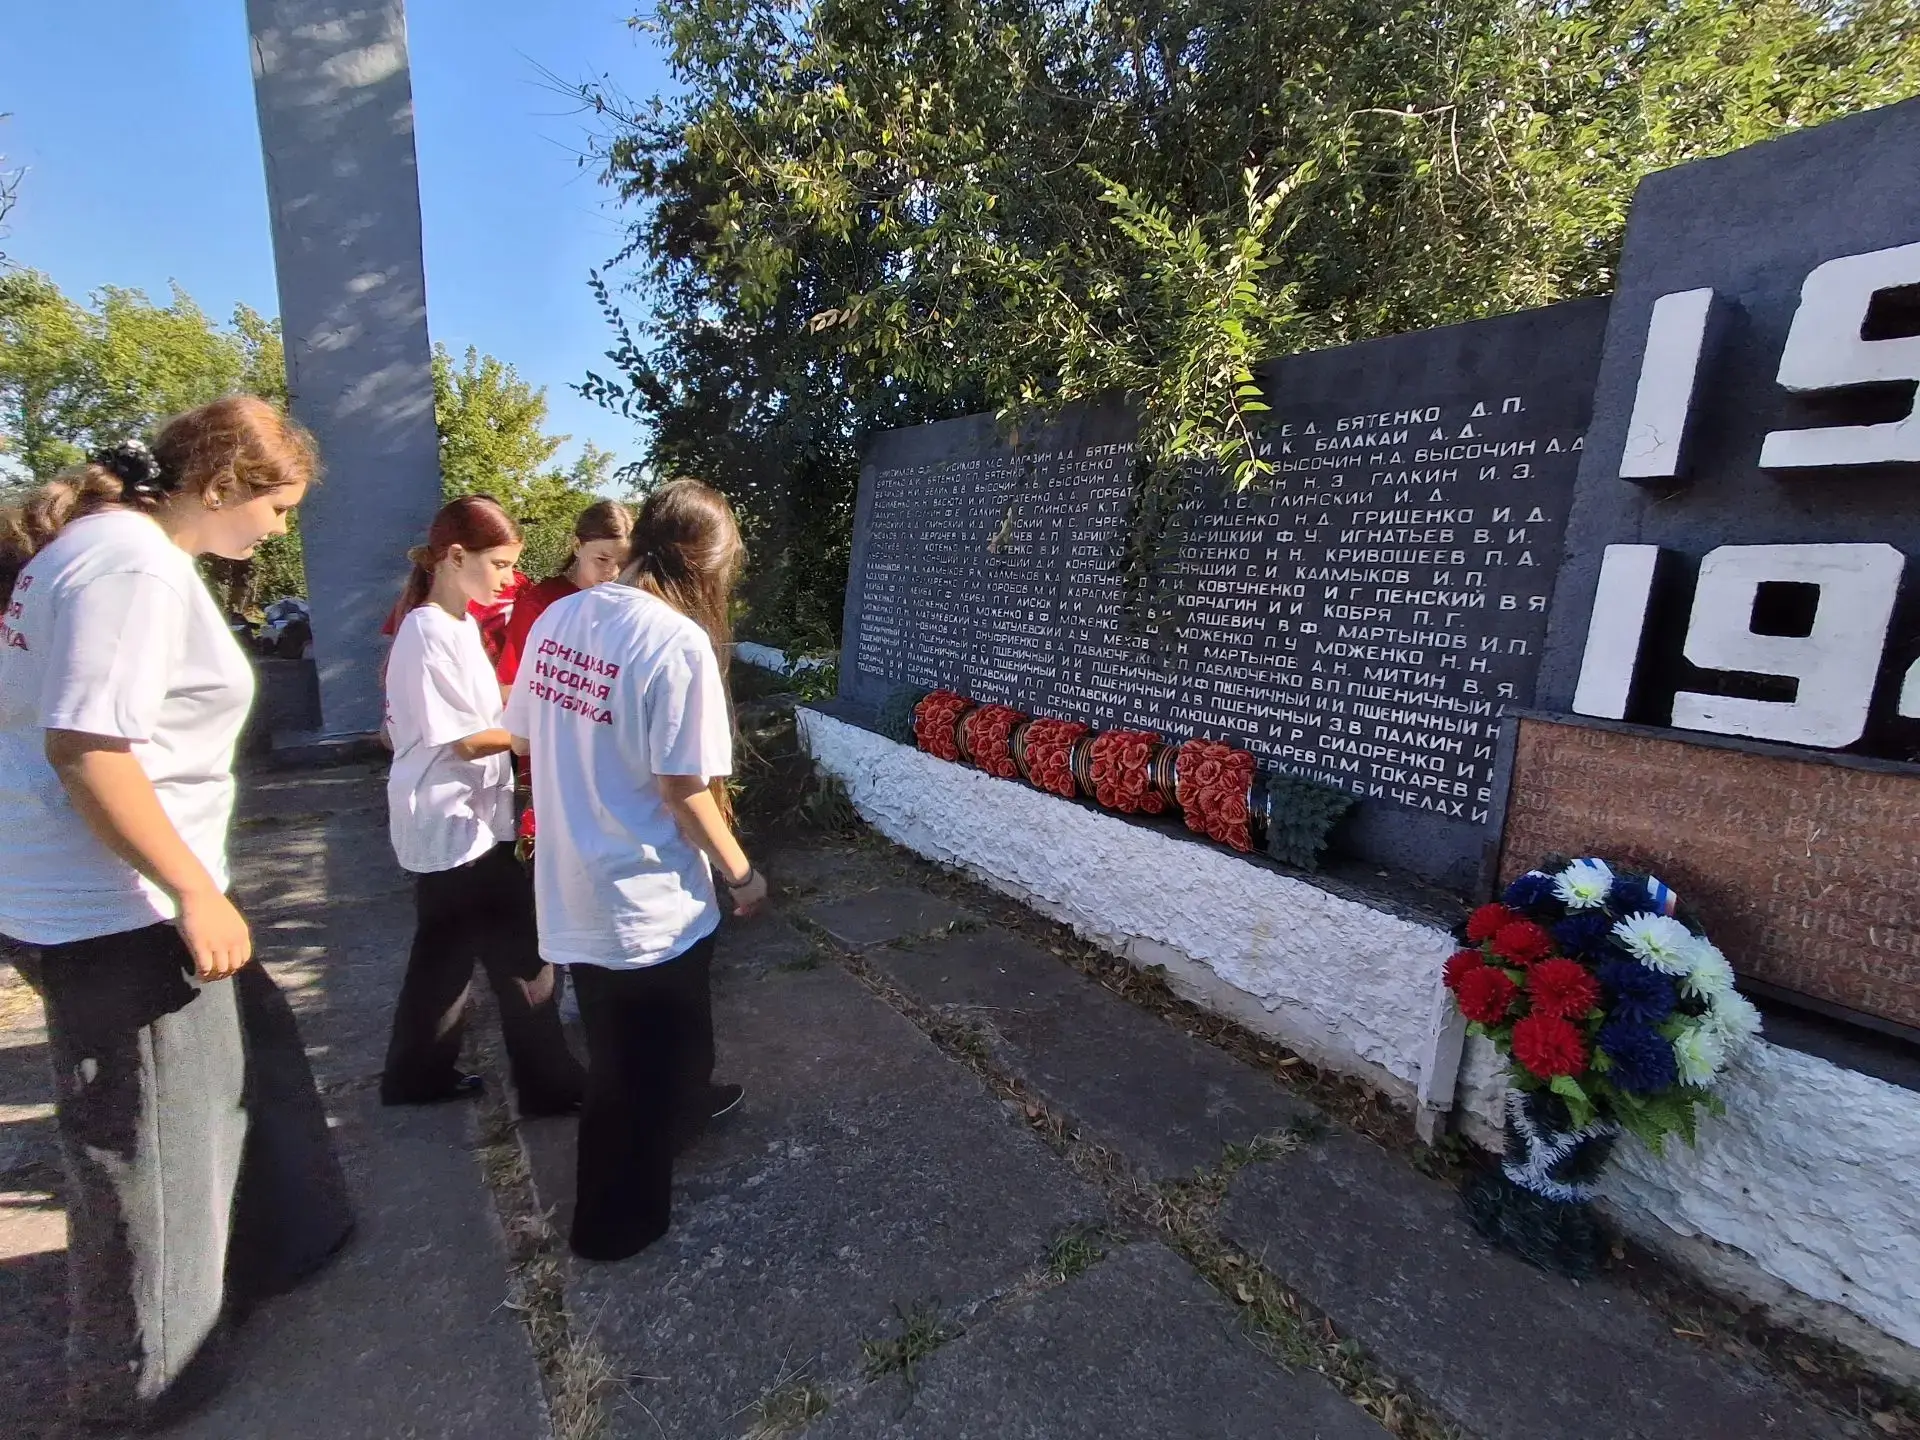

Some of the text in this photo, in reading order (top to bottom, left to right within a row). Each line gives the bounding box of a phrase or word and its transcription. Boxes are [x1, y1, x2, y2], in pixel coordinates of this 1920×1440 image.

[1335, 405, 1441, 432] БЯТЕНКО
[1413, 438, 1536, 464] ВЫСОЧИН
[1058, 457, 1113, 473] БЯТЕНКО
[1370, 466, 1459, 487] ГАЛКИН
[1033, 502, 1088, 515] ГЛИНСКАЯ
[1351, 507, 1474, 525] ГРИЦЕНКО
[1339, 528, 1456, 545] ИГНАТЬЕВ
[1324, 547, 1467, 566] КРИВОШЕЕВ
[1295, 566, 1412, 585] КАЛМЫКОВ
[1197, 579, 1306, 598] КОВТУНЕНКО
[1374, 587, 1487, 610] ПЕНСКИЙ
[1176, 594, 1257, 612] КОРЧАГИН
[1323, 604, 1393, 624] КОБРЯ
[976, 605, 1022, 619] МОЖЕНКО
[1174, 625, 1254, 646] МОЖЕНКО
[1314, 639, 1424, 666] МОЖЕНКО
[1017, 596, 1052, 609] ЛИСЮК
[1187, 610, 1265, 630] ЛЯШЕВИЧ
[1338, 623, 1469, 650] МАРТЫНОВ
[975, 629, 1038, 648] ОНУФРИЕНКО
[1195, 660, 1303, 688] ПАВЛЮЧЕНКО
[1362, 664, 1446, 690] МИТИН
[971, 677, 1010, 695] САРАНЧА
[1047, 694, 1090, 714] СЕНЬКО
[1242, 736, 1317, 765] ТОКАРЕВ
[1368, 762, 1471, 800] ТОКАРЕВ
[1373, 724, 1463, 756] ПАЛКИН
[969, 689, 998, 705] ХОДАН
[1032, 704, 1071, 723] ШИПКО
[1389, 787, 1464, 819] ЧЕЛАХ
[1317, 733, 1446, 774] СИДОРЕНКО
